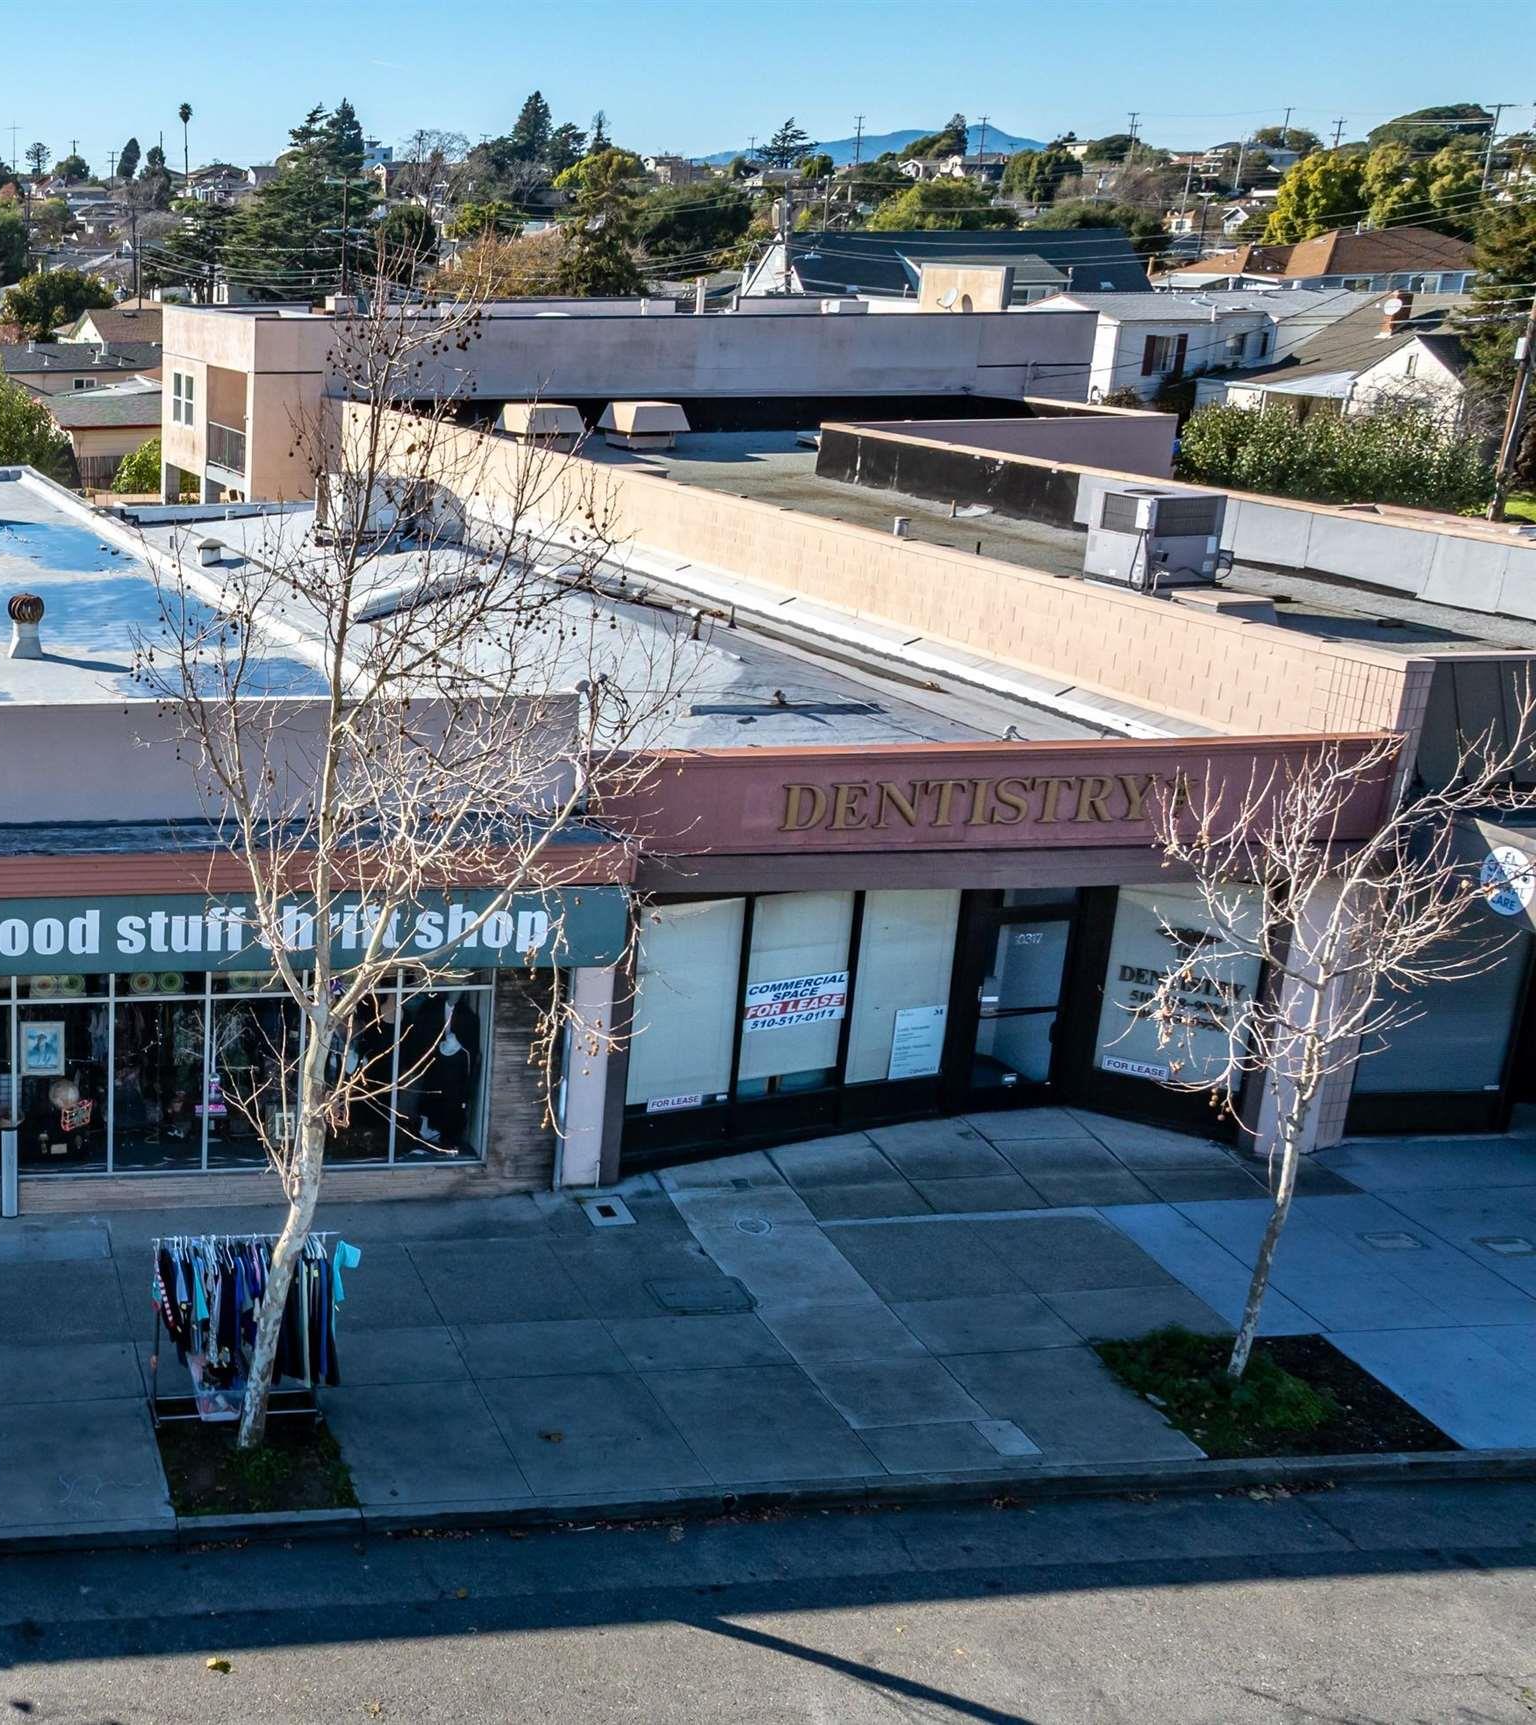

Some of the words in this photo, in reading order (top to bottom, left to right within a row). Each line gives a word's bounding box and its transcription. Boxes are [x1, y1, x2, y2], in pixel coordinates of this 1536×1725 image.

[777, 773, 1163, 832] DENTISTRY
[116, 906, 247, 954] stuff
[414, 903, 549, 953] shop
[748, 974, 846, 996] COMMERCIAL
[771, 986, 820, 1002] SPACE
[745, 1003, 783, 1020] FOR
[785, 994, 845, 1013] LEASE
[750, 1008, 836, 1030] 510-517-0111
[1106, 1059, 1129, 1071] FOR
[1130, 1065, 1165, 1078] LEASE
[651, 1098, 670, 1109] FOR
[672, 1095, 701, 1106] LEASE
